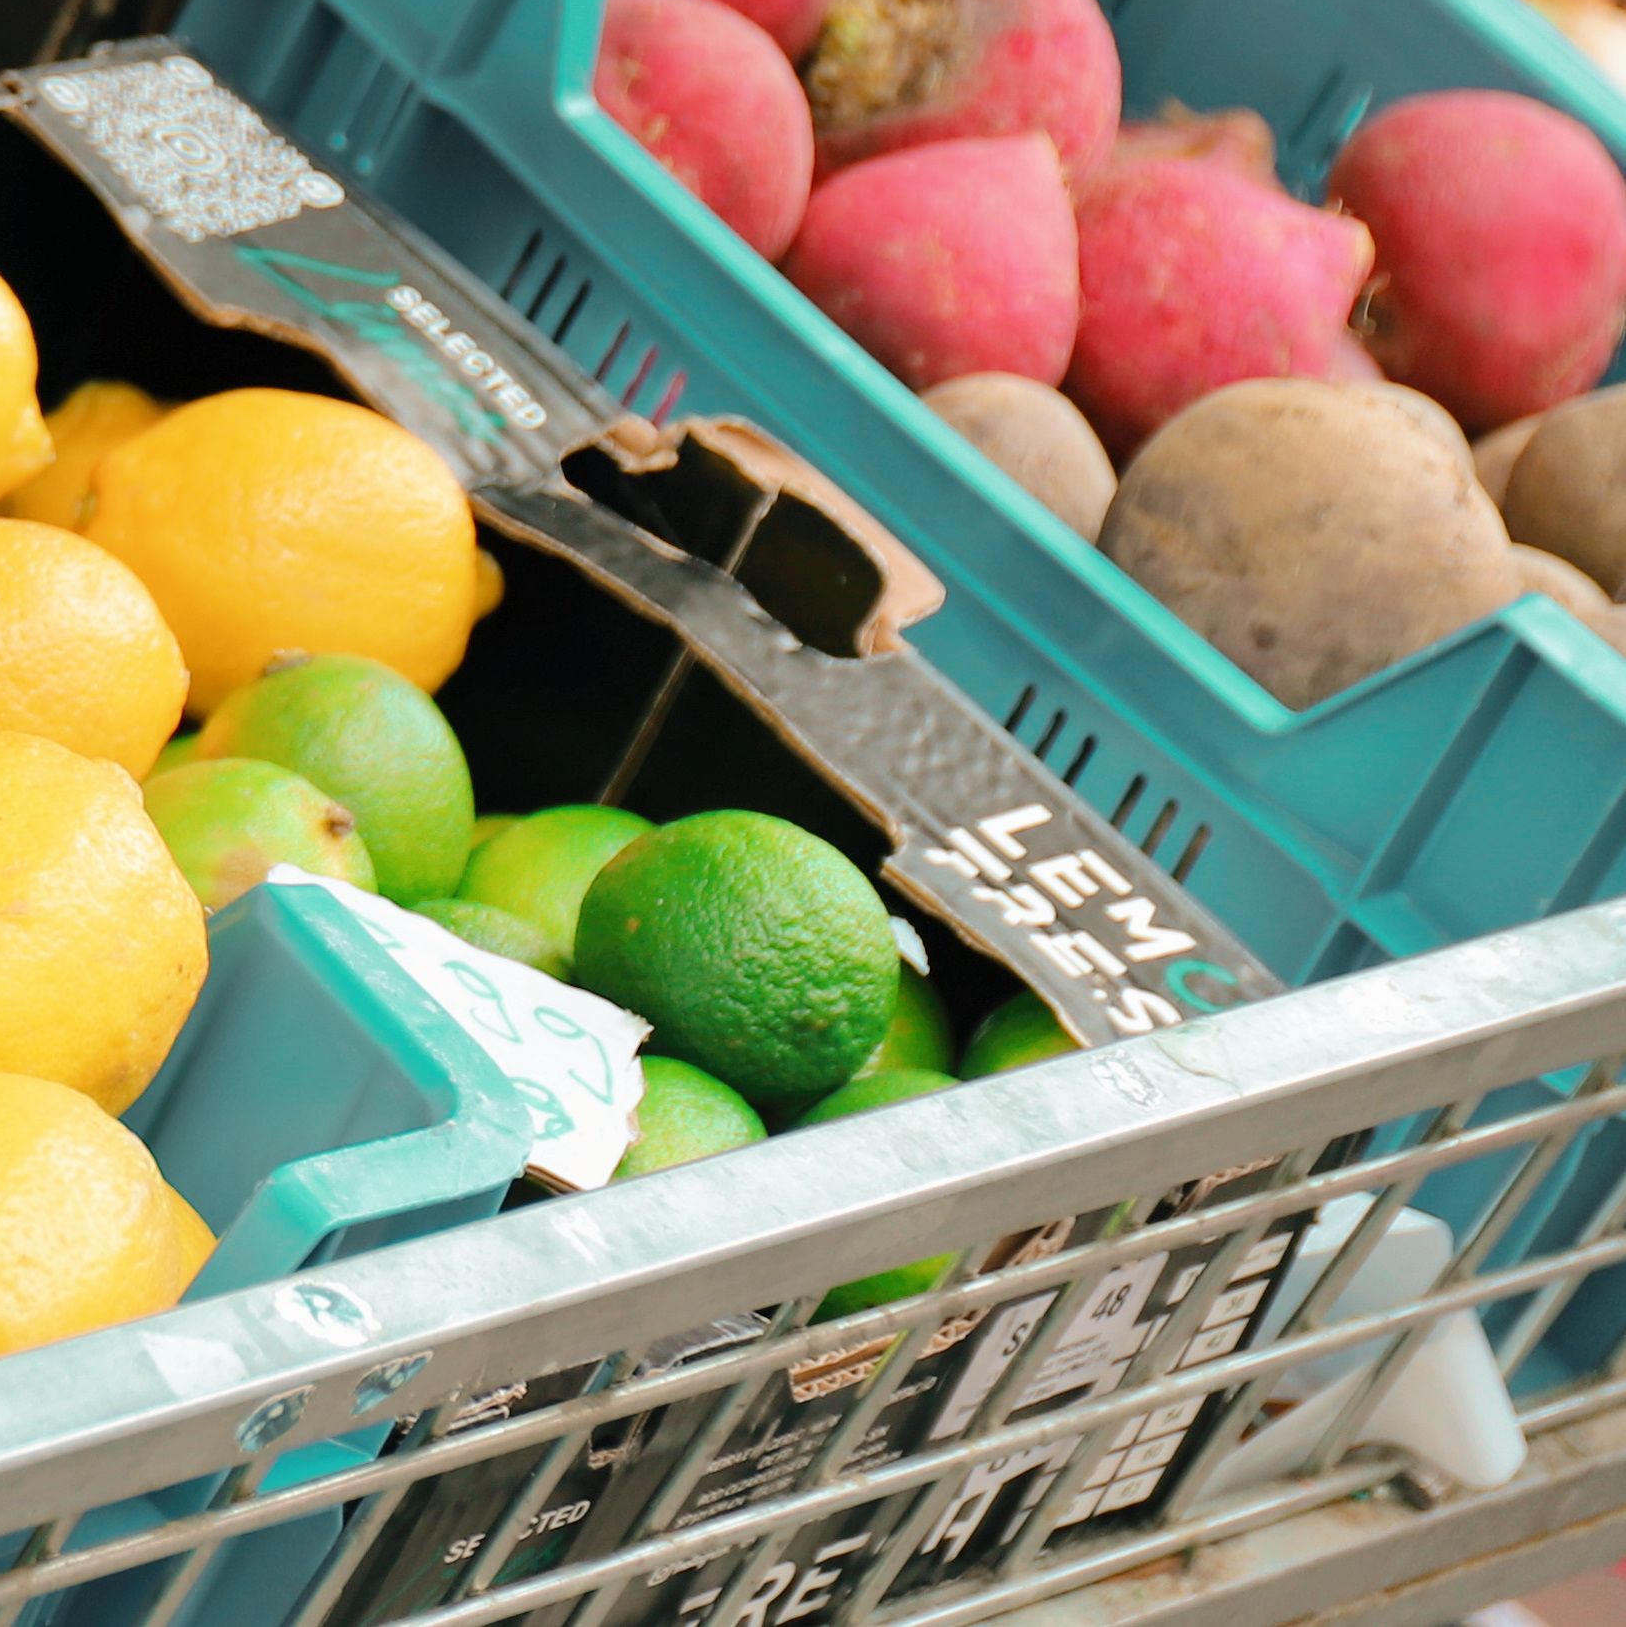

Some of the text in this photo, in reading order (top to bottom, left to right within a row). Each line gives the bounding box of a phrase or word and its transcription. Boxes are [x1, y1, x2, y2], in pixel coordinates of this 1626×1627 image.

[386, 285, 547, 429] SELECTED
[1090, 1282, 1132, 1320] 48
[443, 1500, 591, 1564] SECTED
